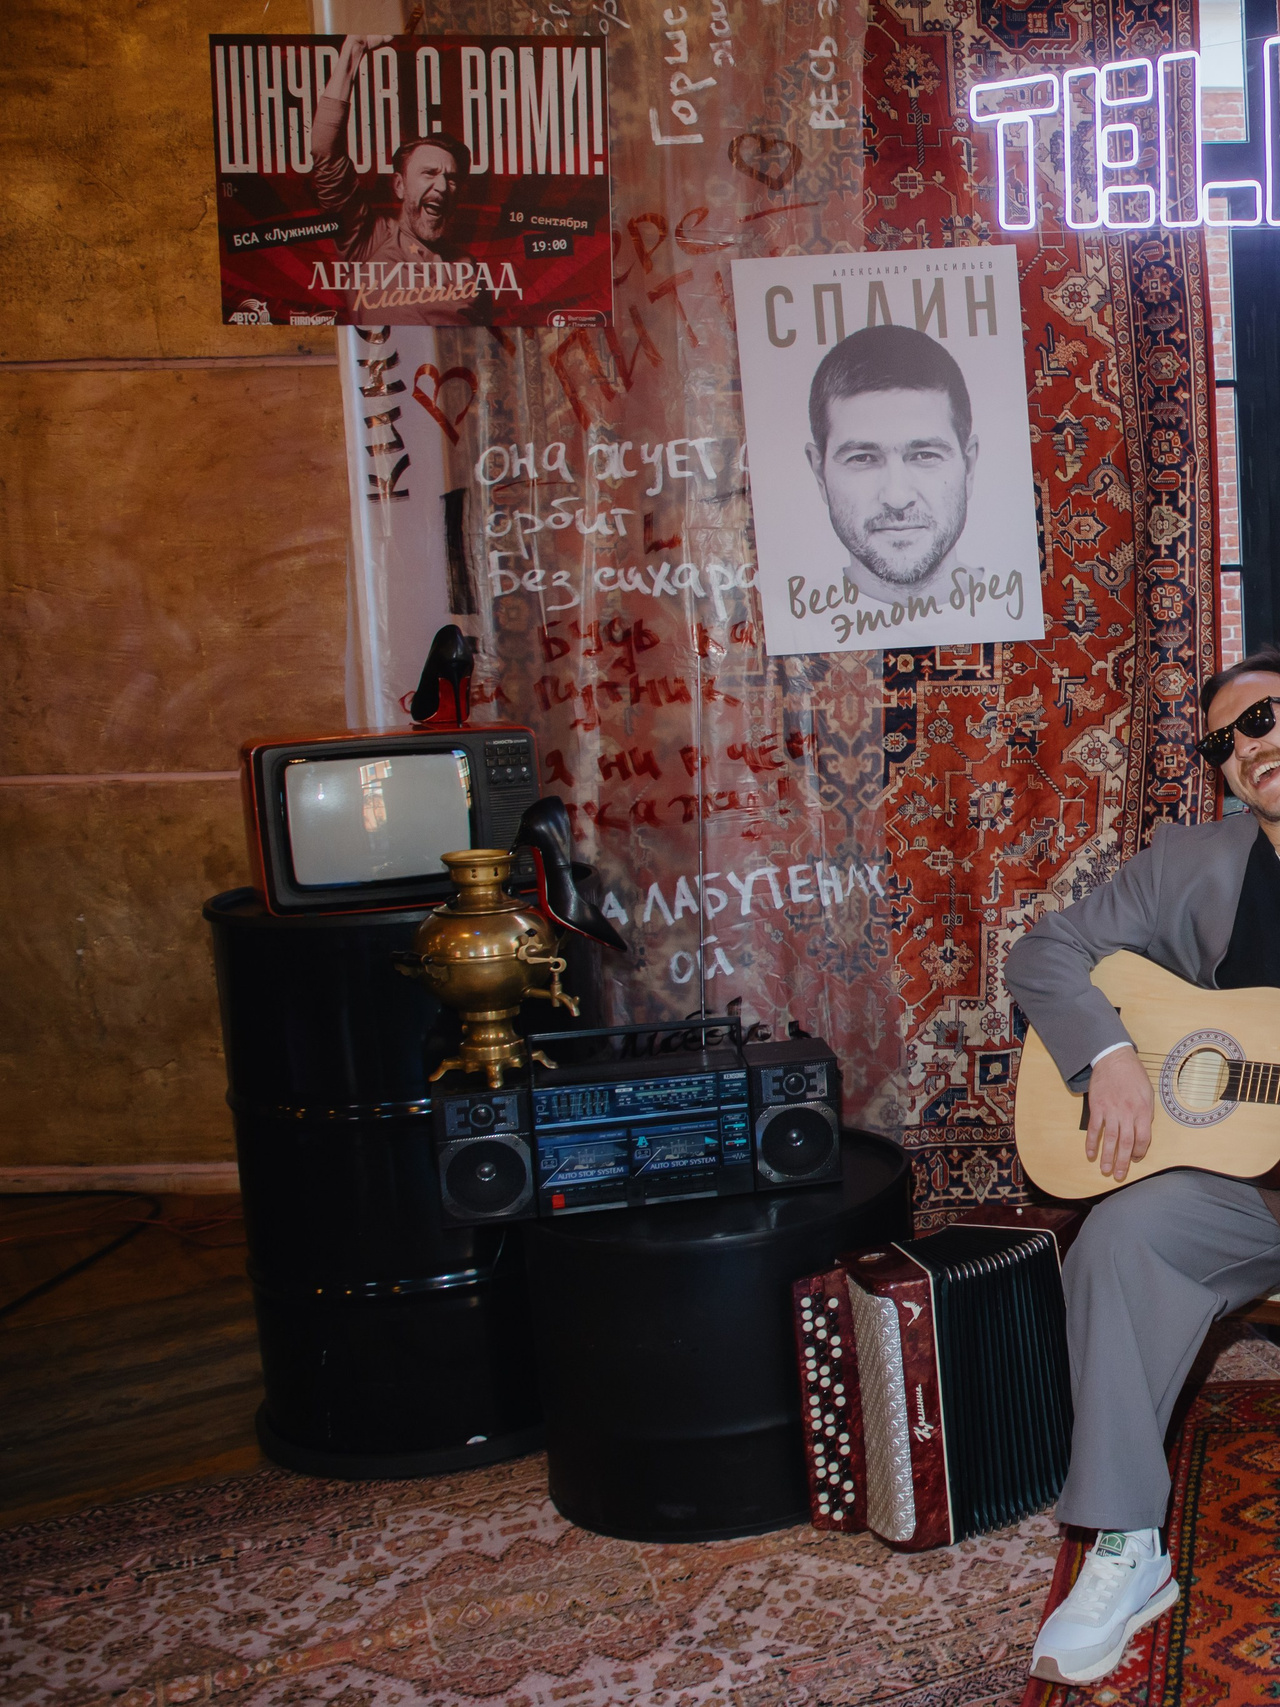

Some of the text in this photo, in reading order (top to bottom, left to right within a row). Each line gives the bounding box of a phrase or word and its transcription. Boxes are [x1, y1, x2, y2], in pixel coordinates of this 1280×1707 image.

[215, 46, 400, 174] ШНУРОВ
[461, 47, 604, 175] ВАМИ!
[509, 211, 589, 230] 10 сентября
[233, 222, 340, 247] БСА «Лужники»
[532, 239, 568, 252] 19:00
[832, 261, 993, 278] АЛЕКСАНДР ВАСИЛЬЕВ
[308, 261, 523, 301] ЛЕНИНГРАД
[353, 279, 480, 312] Классика
[228, 311, 259, 323] АВТО
[764, 274, 998, 349] СПЛИН
[787, 574, 860, 620] Весь
[949, 567, 1024, 621] бред
[723, 1071, 747, 1081] KENSONIC
[650, 1156, 716, 1171] AUTO STOP SYSTEM
[557, 1166, 624, 1181] AUTO STOP SYSTEM
